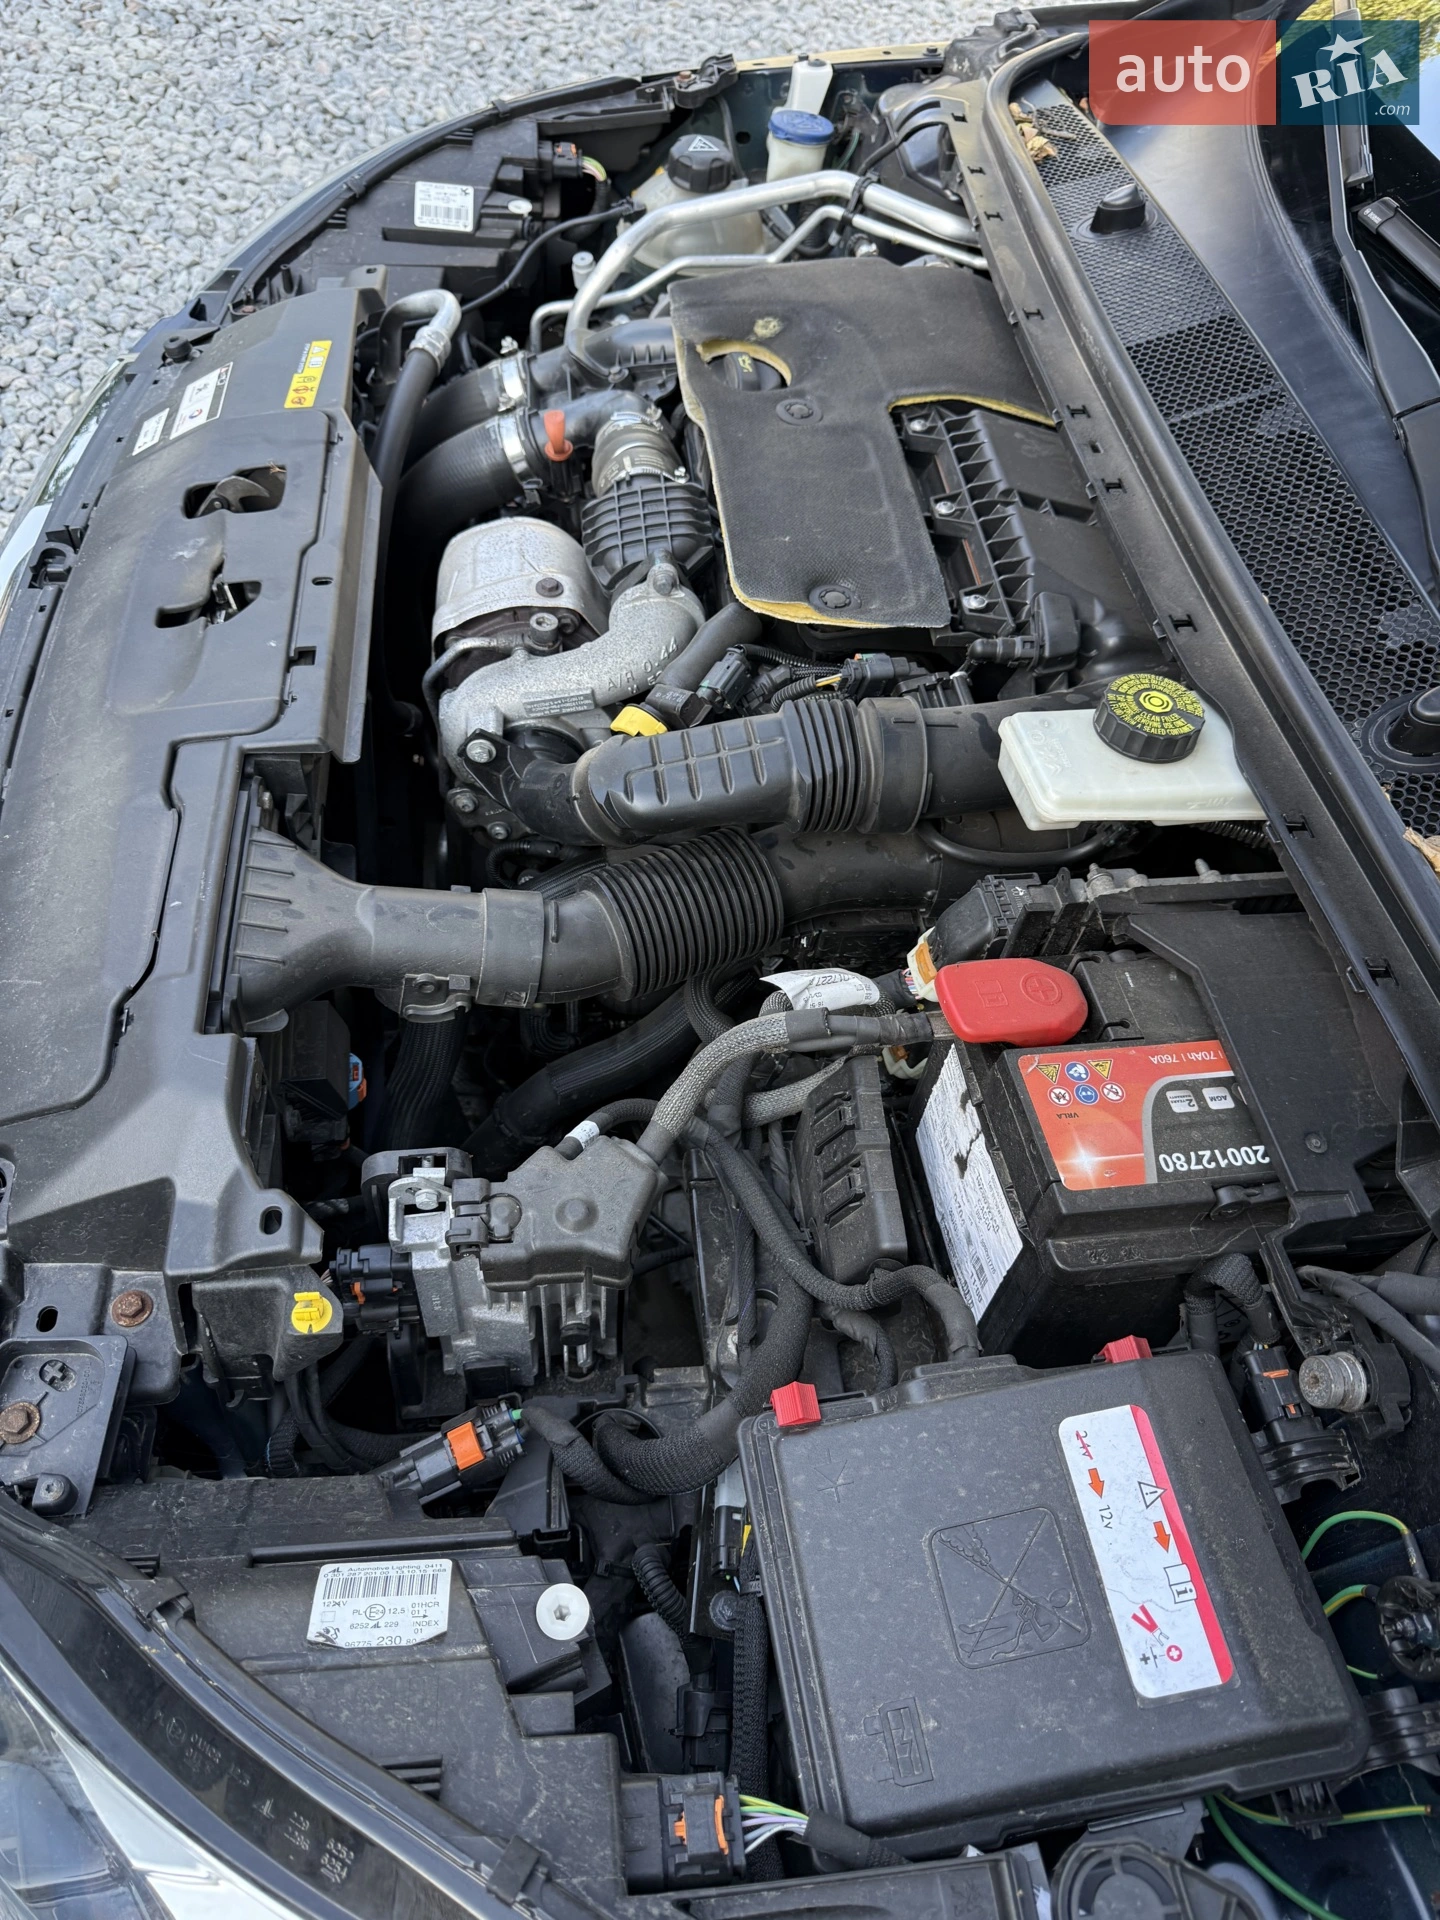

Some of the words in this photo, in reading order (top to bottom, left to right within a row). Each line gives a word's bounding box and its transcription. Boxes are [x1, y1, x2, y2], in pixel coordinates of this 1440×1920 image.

[1140, 711, 1160, 722] CLEAN
[1143, 725, 1166, 736] SEALED
[1149, 1054, 1180, 1065] 760A
[1186, 1052, 1217, 1062] 70Ah
[1186, 1099, 1196, 1108] 2
[1208, 1094, 1228, 1103] AGM
[1056, 1112, 1080, 1120] VRLA
[1158, 1145, 1270, 1173] 20012780
[1098, 1504, 1113, 1530] 12v
[411, 1601, 440, 1609] 01HCR
[376, 1635, 402, 1646] 230
[326, 1838, 354, 1865] 6252
